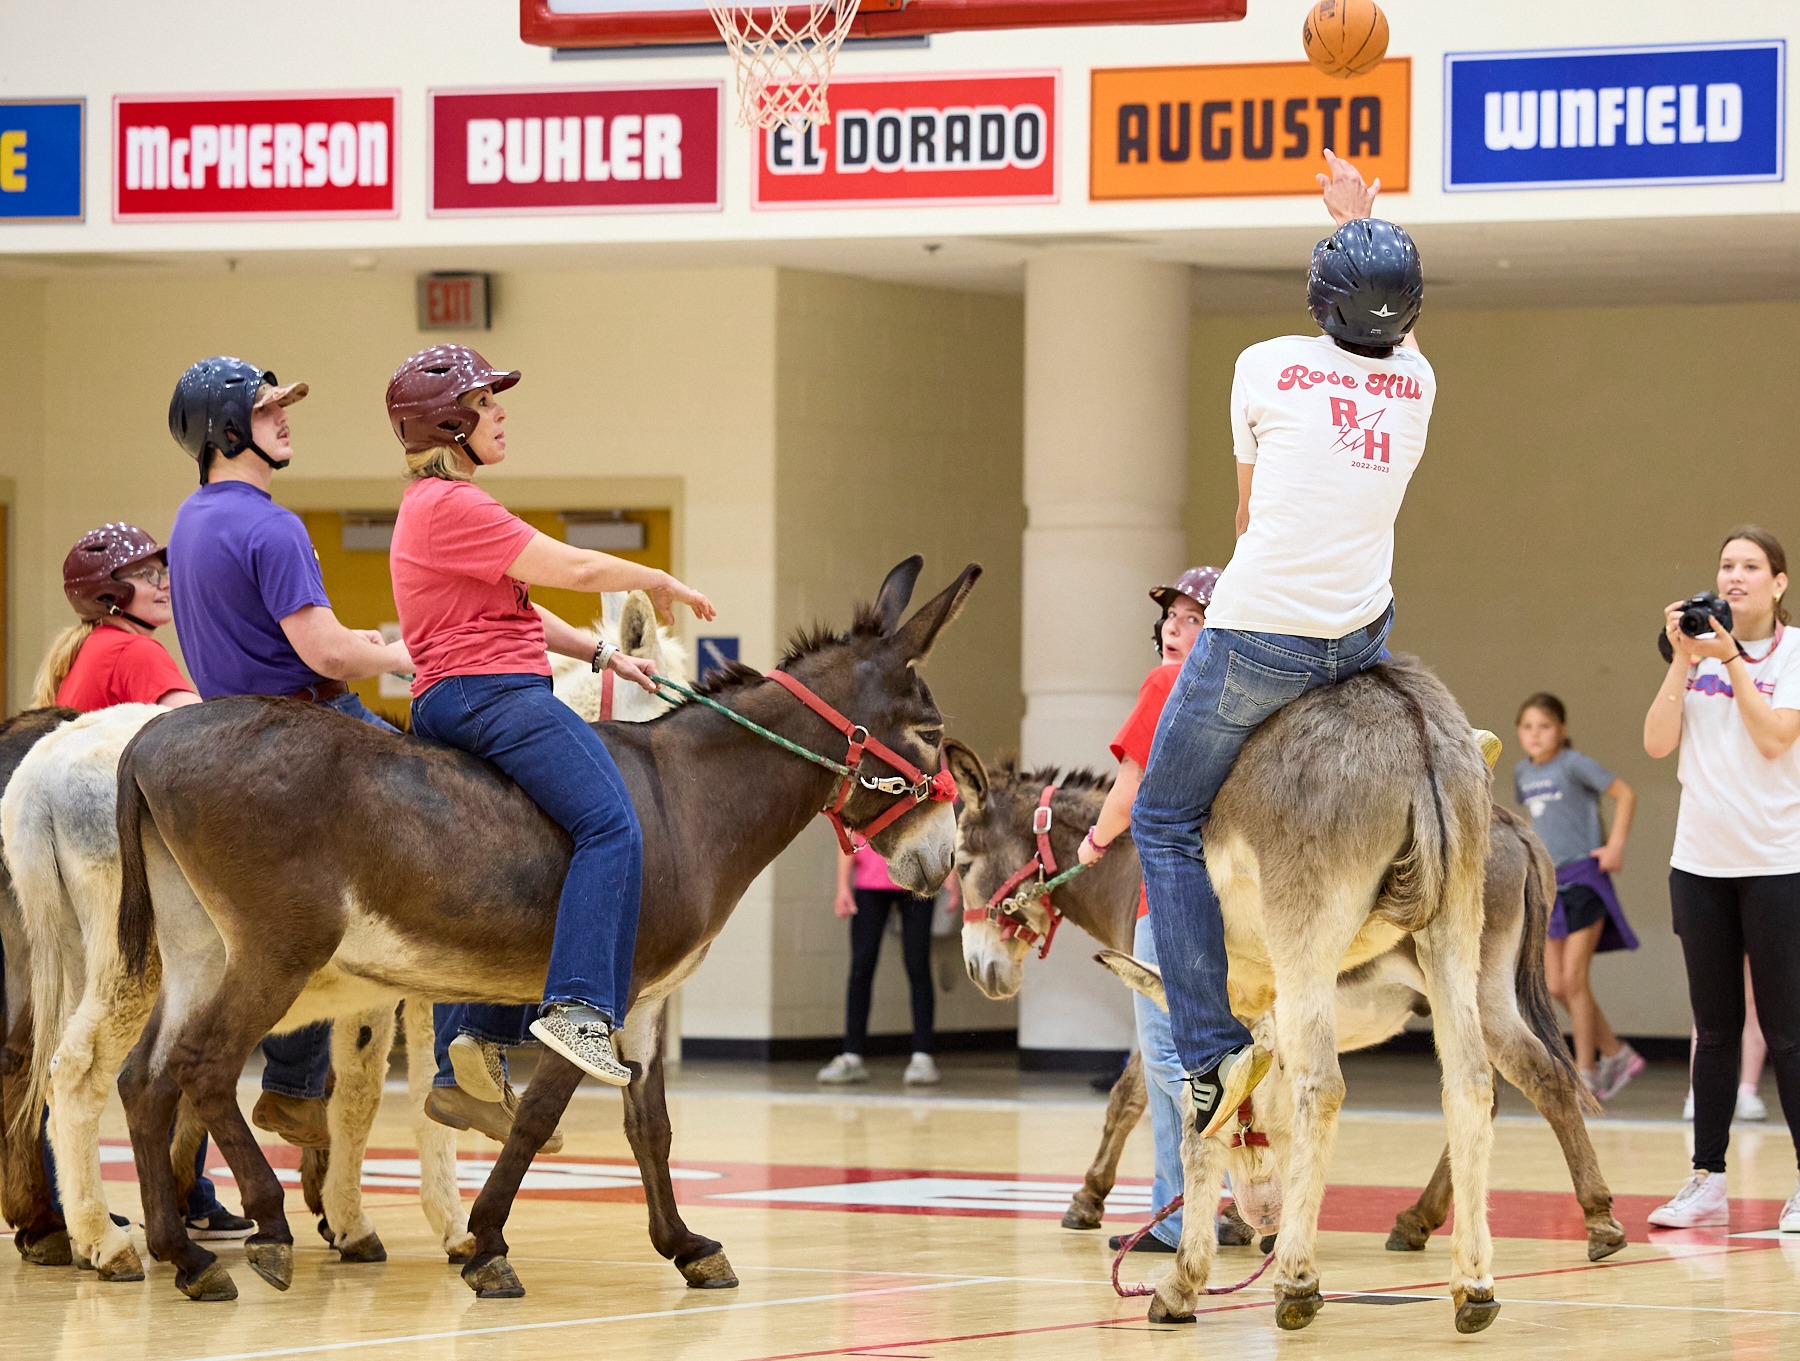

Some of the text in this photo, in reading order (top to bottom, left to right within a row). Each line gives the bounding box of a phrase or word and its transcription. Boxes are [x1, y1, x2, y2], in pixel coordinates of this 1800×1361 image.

[772, 111, 1042, 168] EL DORADO
[1117, 95, 1382, 165] AUGUSTA
[1483, 83, 1744, 151] WINFIELD
[125, 121, 389, 190] McPHERSON
[466, 114, 683, 185] BUHLER
[427, 280, 472, 324] EXIT
[1277, 364, 1423, 400] Rose Hill
[1350, 460, 1390, 474] 2022-2023
